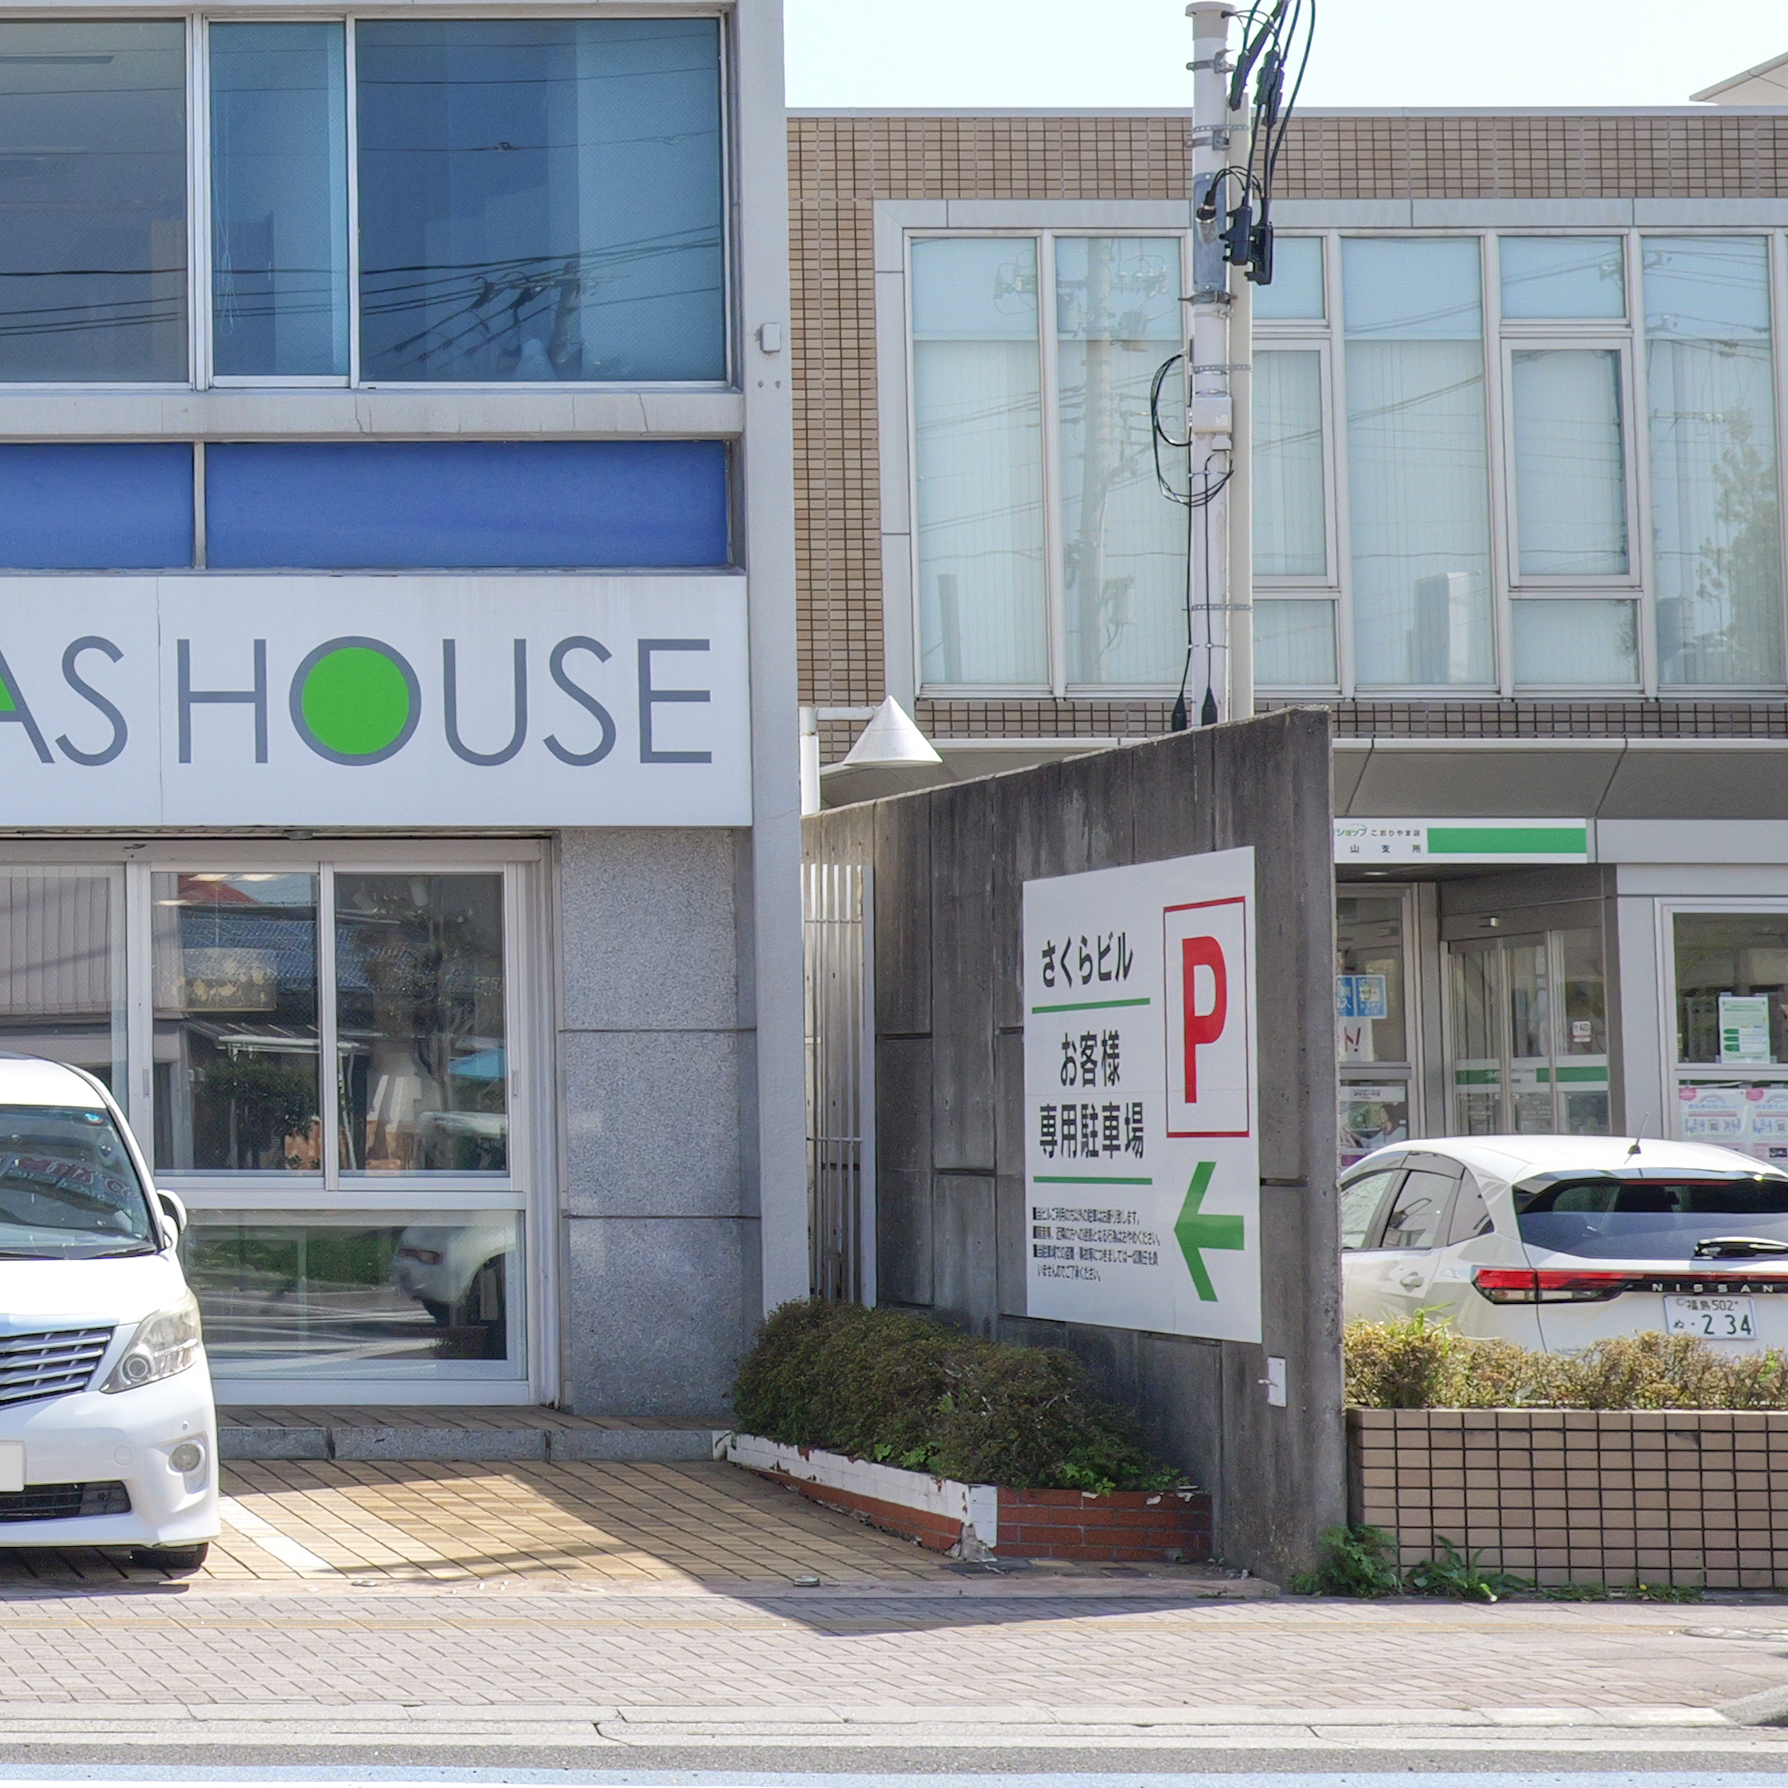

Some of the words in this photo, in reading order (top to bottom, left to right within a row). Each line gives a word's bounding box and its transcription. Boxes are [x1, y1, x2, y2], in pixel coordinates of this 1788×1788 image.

[178, 635, 712, 767] HOUSE
[1042, 931, 1134, 989] さくらビル
[1182, 936, 1227, 1103] P
[1060, 1030, 1120, 1088] お客様
[1039, 1102, 1144, 1160] 専用駐車場
[1652, 1283, 1774, 1293] NISSAN
